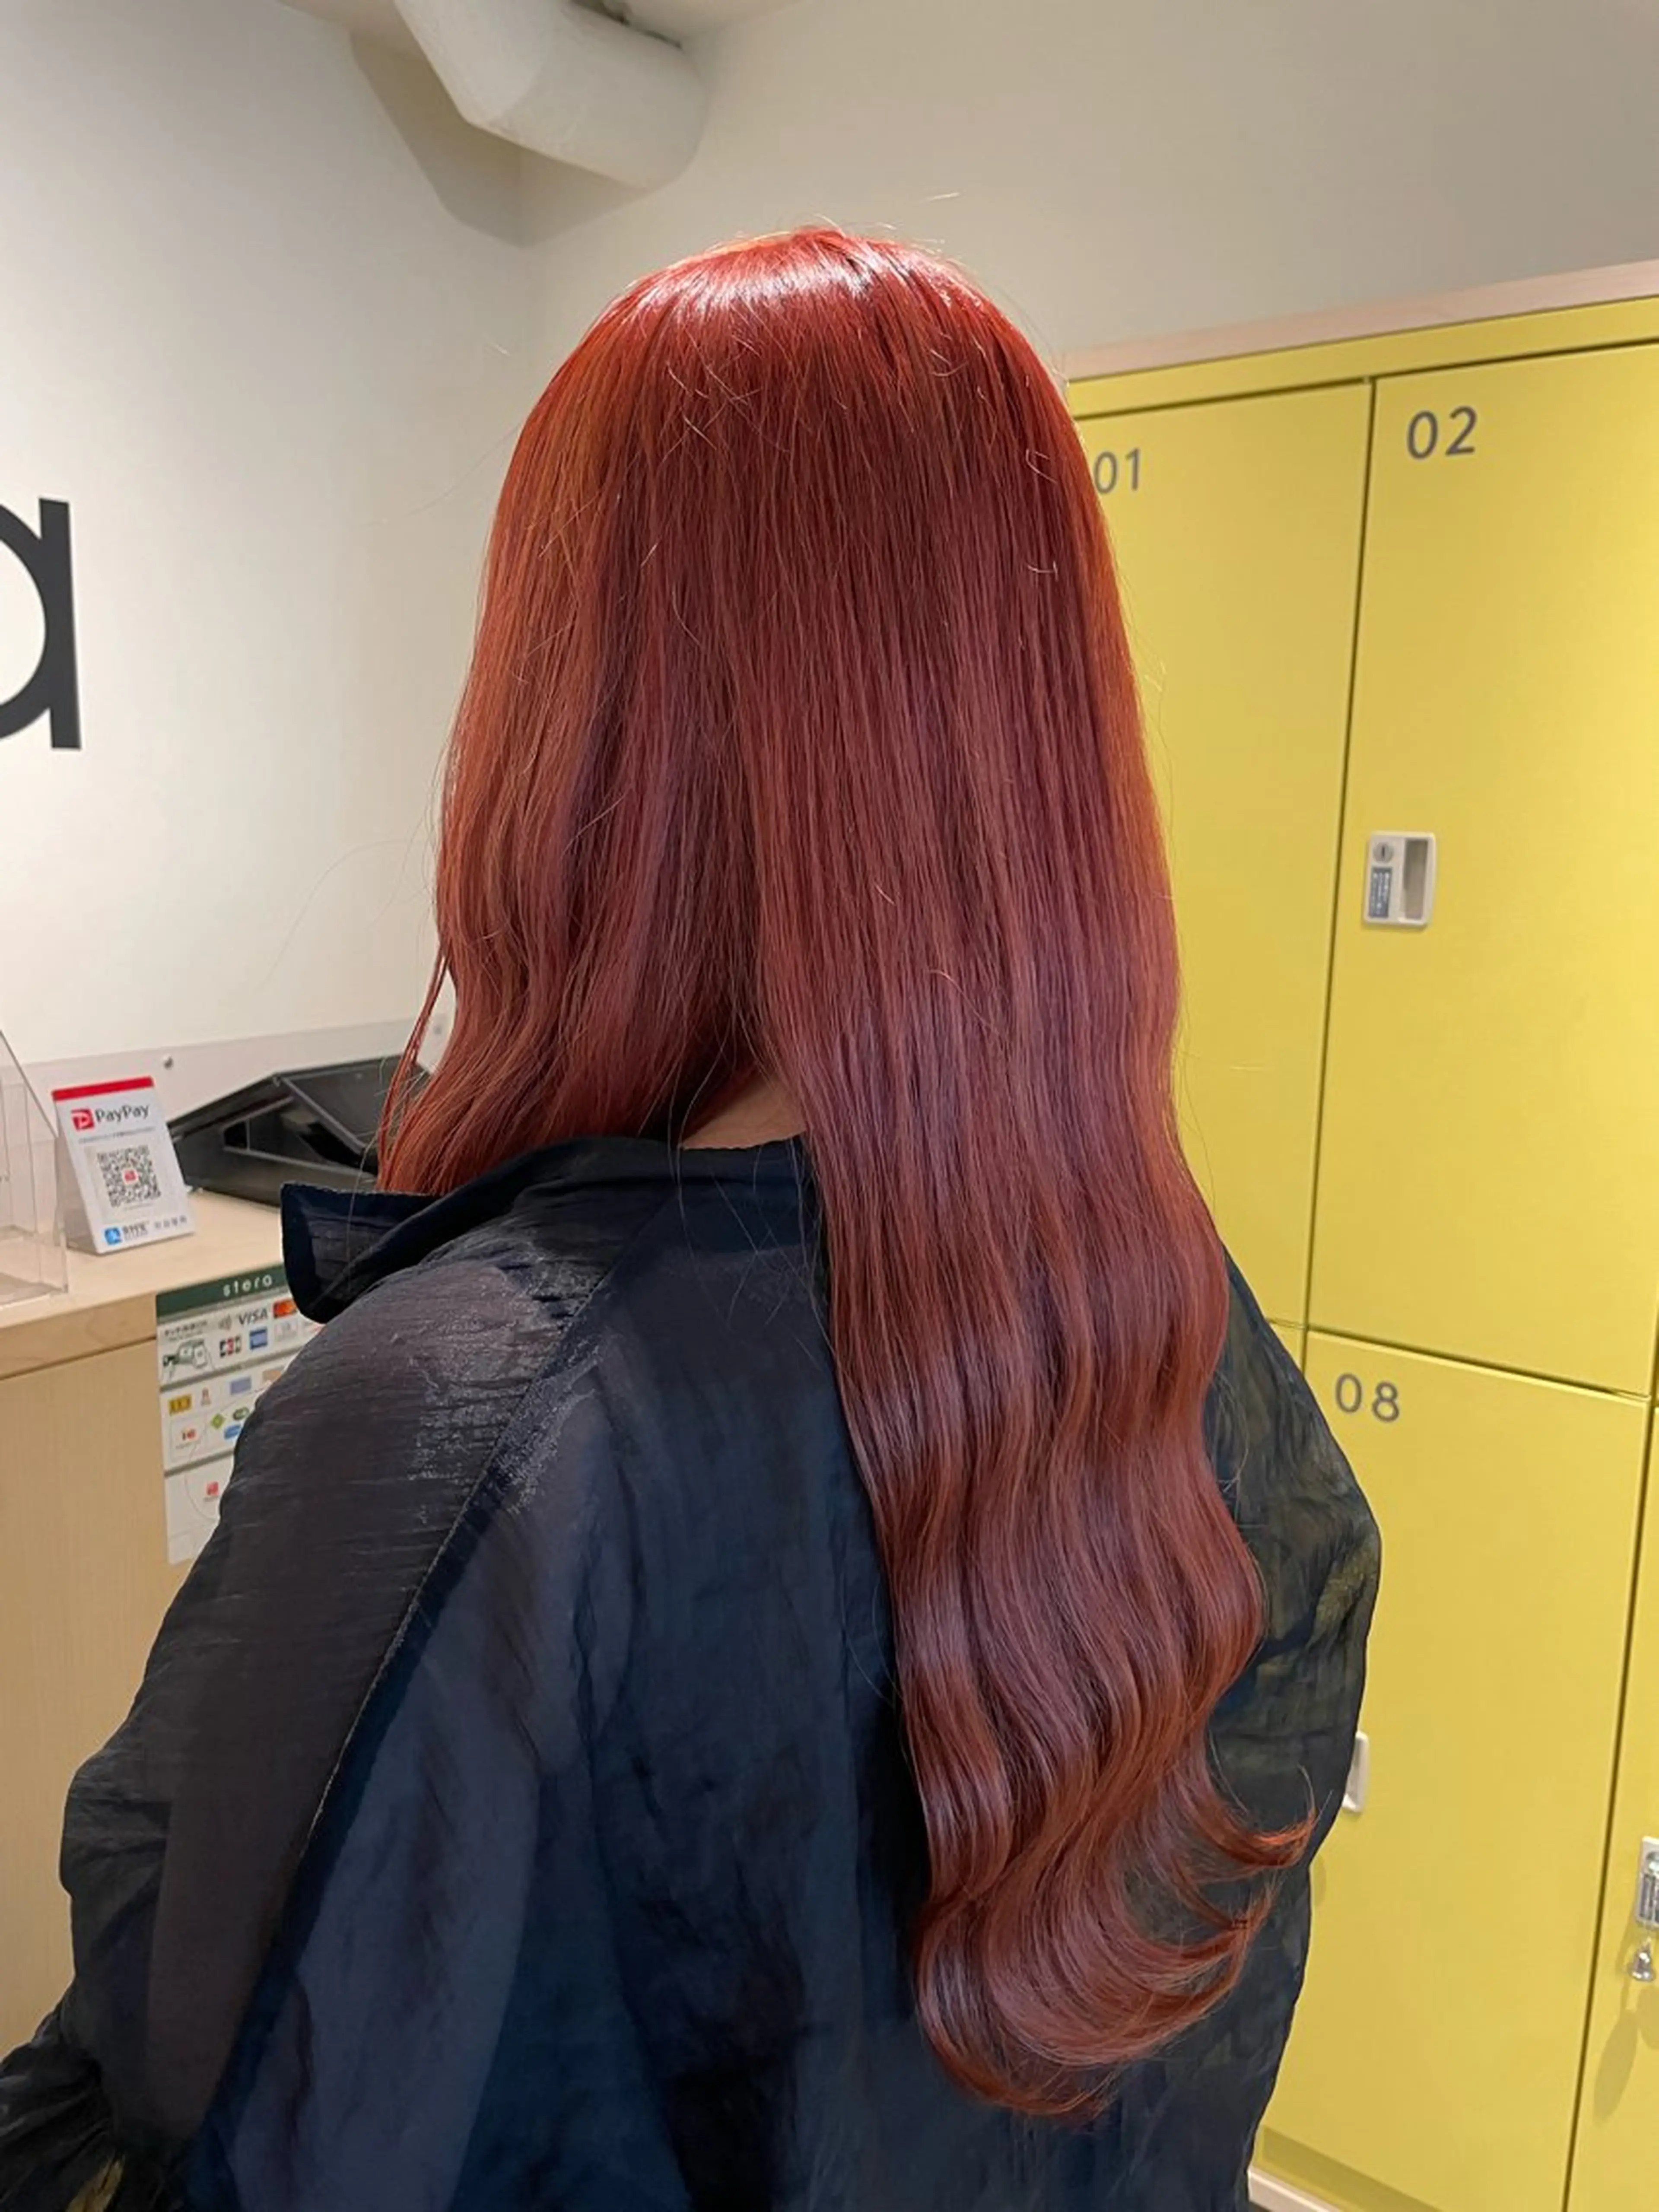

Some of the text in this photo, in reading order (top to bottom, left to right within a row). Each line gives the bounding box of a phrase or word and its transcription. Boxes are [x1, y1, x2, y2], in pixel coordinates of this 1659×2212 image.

[1408, 405, 1477, 458] 02
[1094, 447, 1140, 494] 01
[95, 1104, 149, 1123] PayPay
[238, 1308, 268, 1325] VISA
[1335, 1373, 1399, 1422] 08
